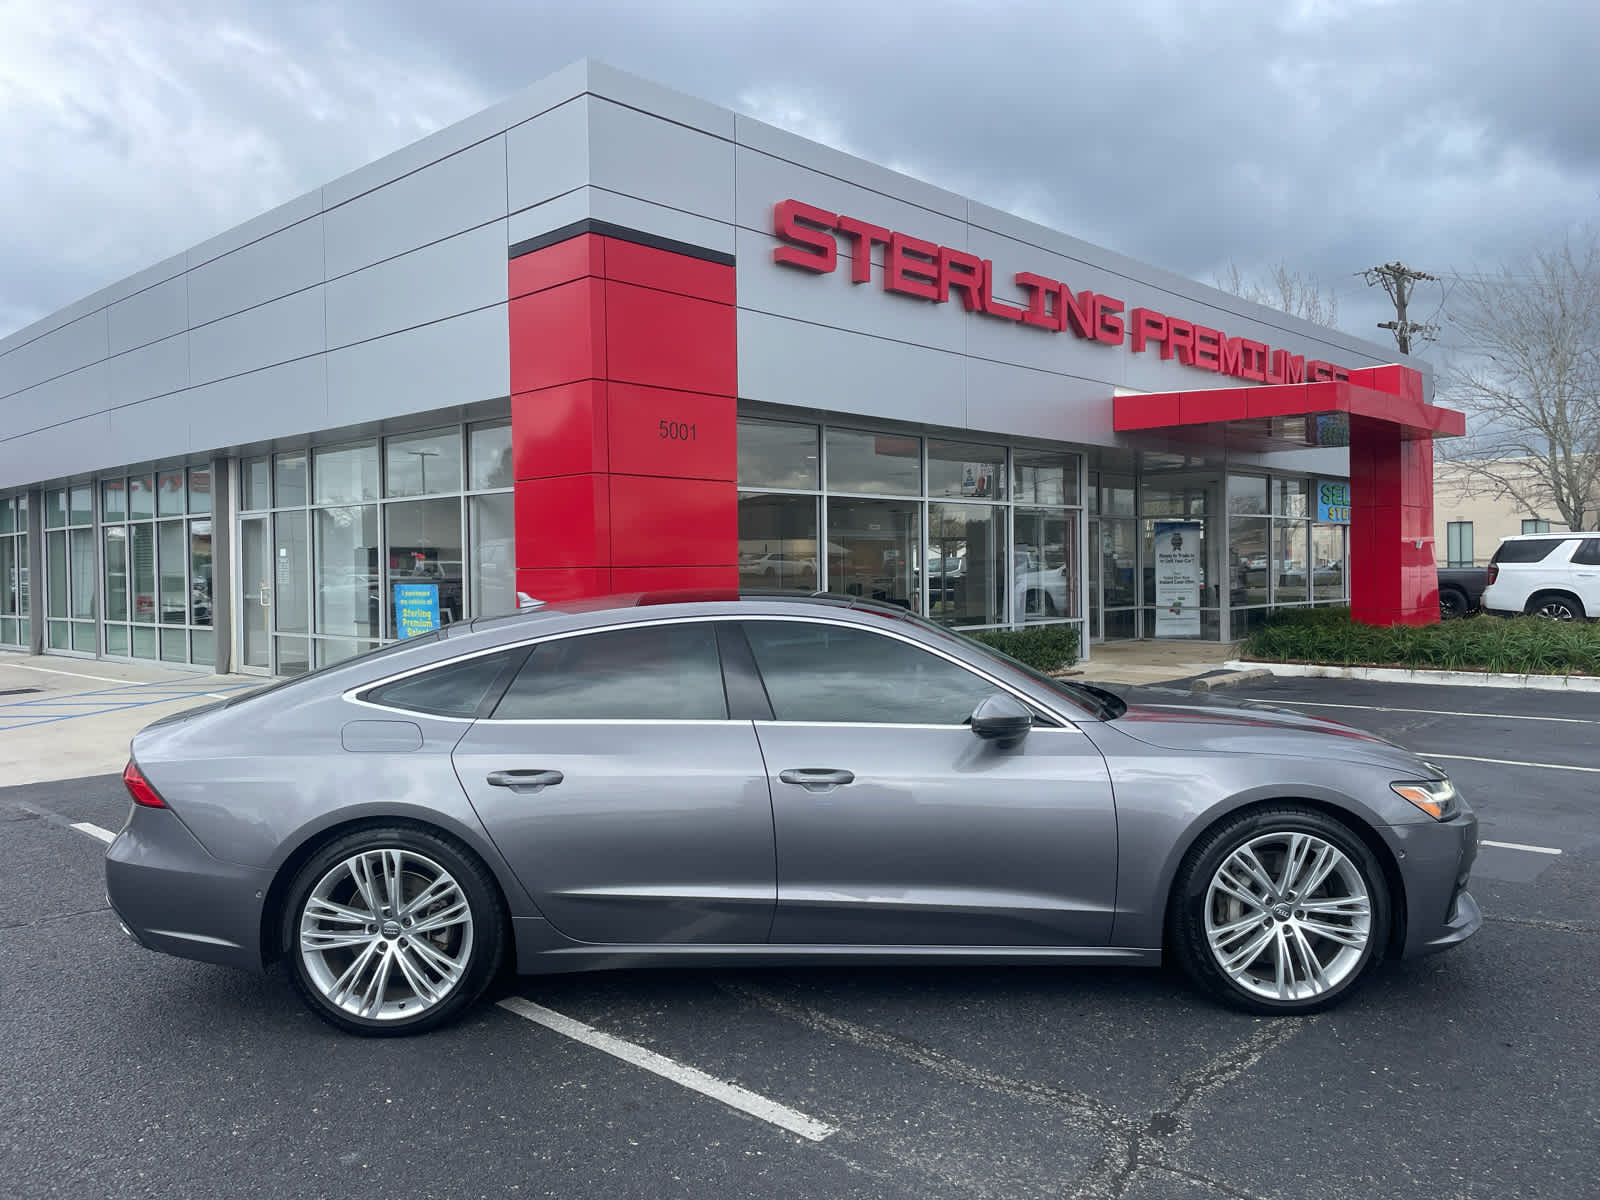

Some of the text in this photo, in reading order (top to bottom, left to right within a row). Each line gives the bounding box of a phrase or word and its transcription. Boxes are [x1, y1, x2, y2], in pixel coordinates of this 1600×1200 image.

[773, 198, 1125, 346] STERLING
[1131, 307, 1305, 385] PREMIUM
[659, 419, 697, 441] 5001
[1328, 506, 1350, 521] STE
